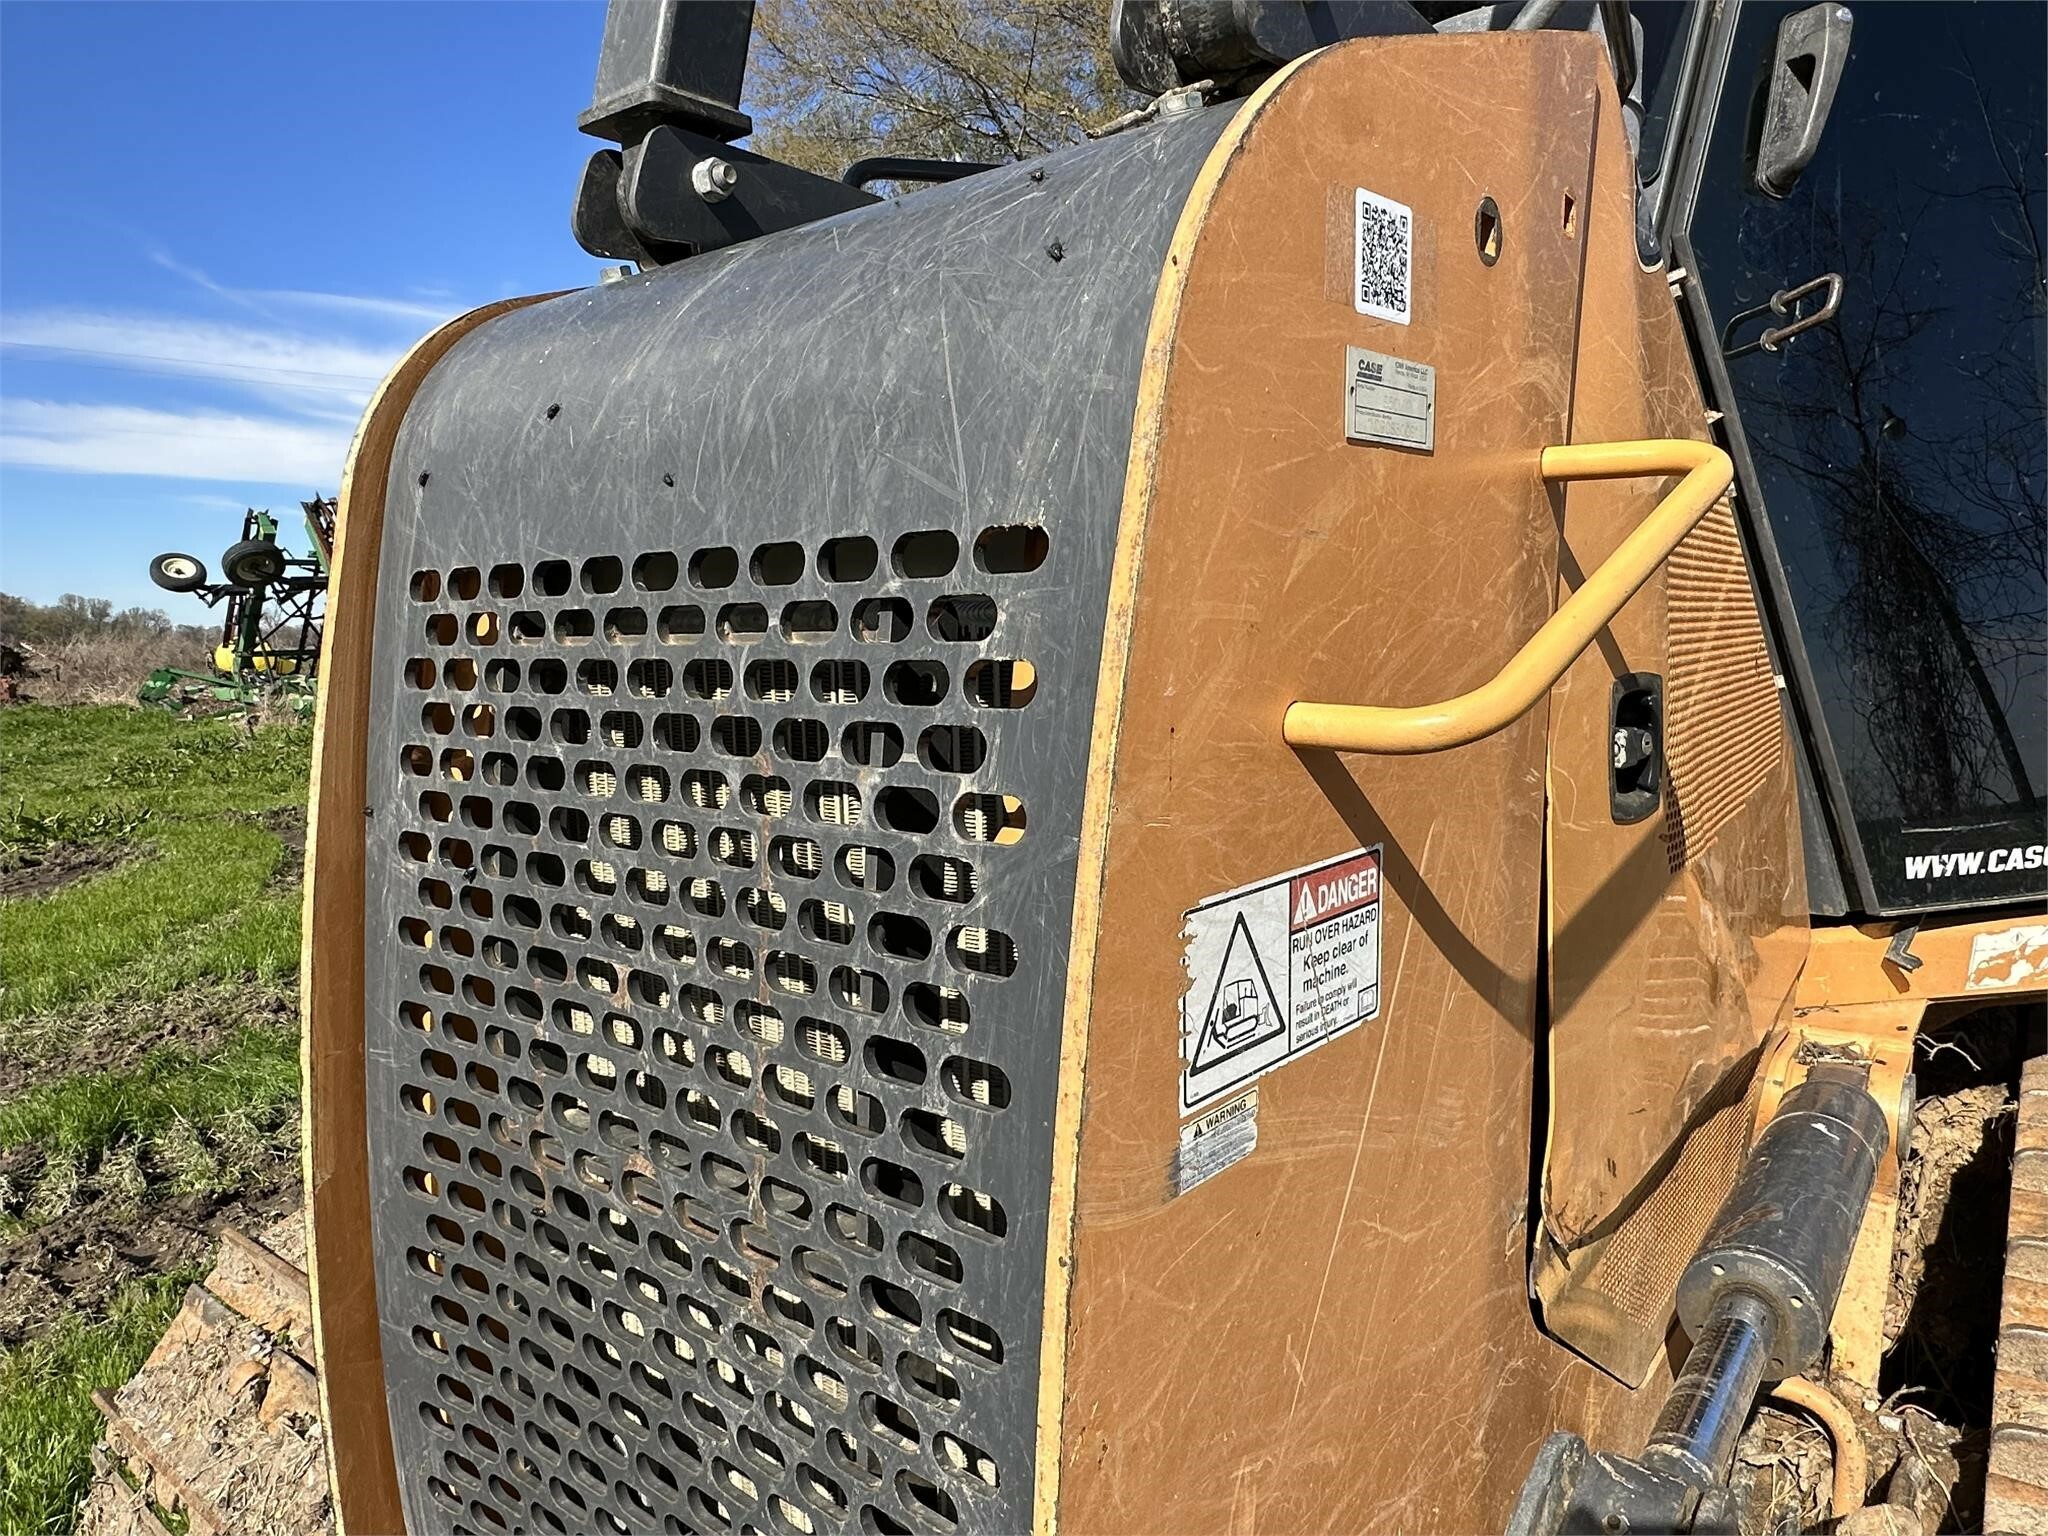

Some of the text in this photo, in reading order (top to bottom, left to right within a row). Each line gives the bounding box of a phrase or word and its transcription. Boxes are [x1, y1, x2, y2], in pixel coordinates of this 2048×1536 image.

[1358, 359, 1383, 374] CASE
[1905, 845, 2048, 880] WWW.CAS
[1318, 867, 1377, 914] DANGER
[1292, 907, 1377, 954] RUN OVER HAZARD
[1303, 929, 1368, 972] Keep clear of
[1303, 963, 1349, 993] machine.
[1295, 998, 1317, 1016] Failure
[1325, 985, 1346, 1001] comply
[1347, 977, 1358, 991] will
[1295, 1011, 1314, 1030] result
[1314, 1009, 1320, 1021] in
[1342, 997, 1350, 1007] or
[1295, 1025, 1319, 1044] serious
[1205, 1098, 1247, 1130] WARNING
